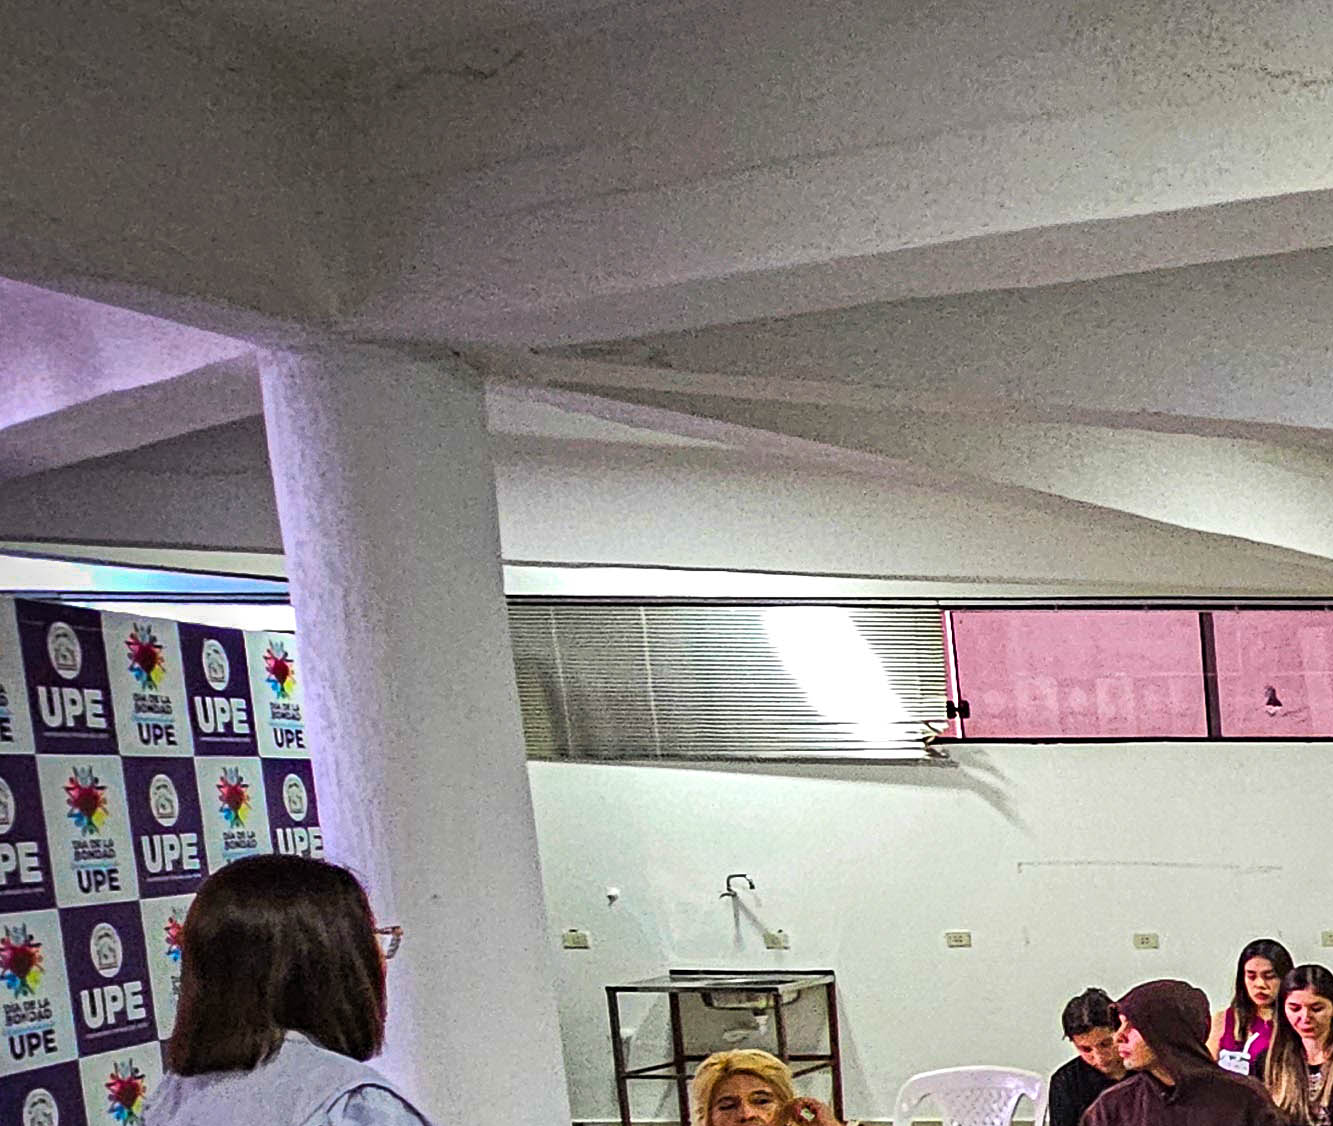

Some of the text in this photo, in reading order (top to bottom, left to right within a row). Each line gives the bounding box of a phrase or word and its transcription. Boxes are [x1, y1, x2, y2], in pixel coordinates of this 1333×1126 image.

[36, 686, 108, 728] UPE
[194, 696, 250, 733] UPE
[138, 722, 178, 745] UPE
[273, 728, 305, 748] UPE
[141, 833, 200, 873] UPE
[276, 827, 325, 861] UPE
[0, 841, 43, 885] PE
[76, 868, 121, 893] UPE
[80, 980, 146, 1029] UPE
[9, 1029, 58, 1060] UPE
